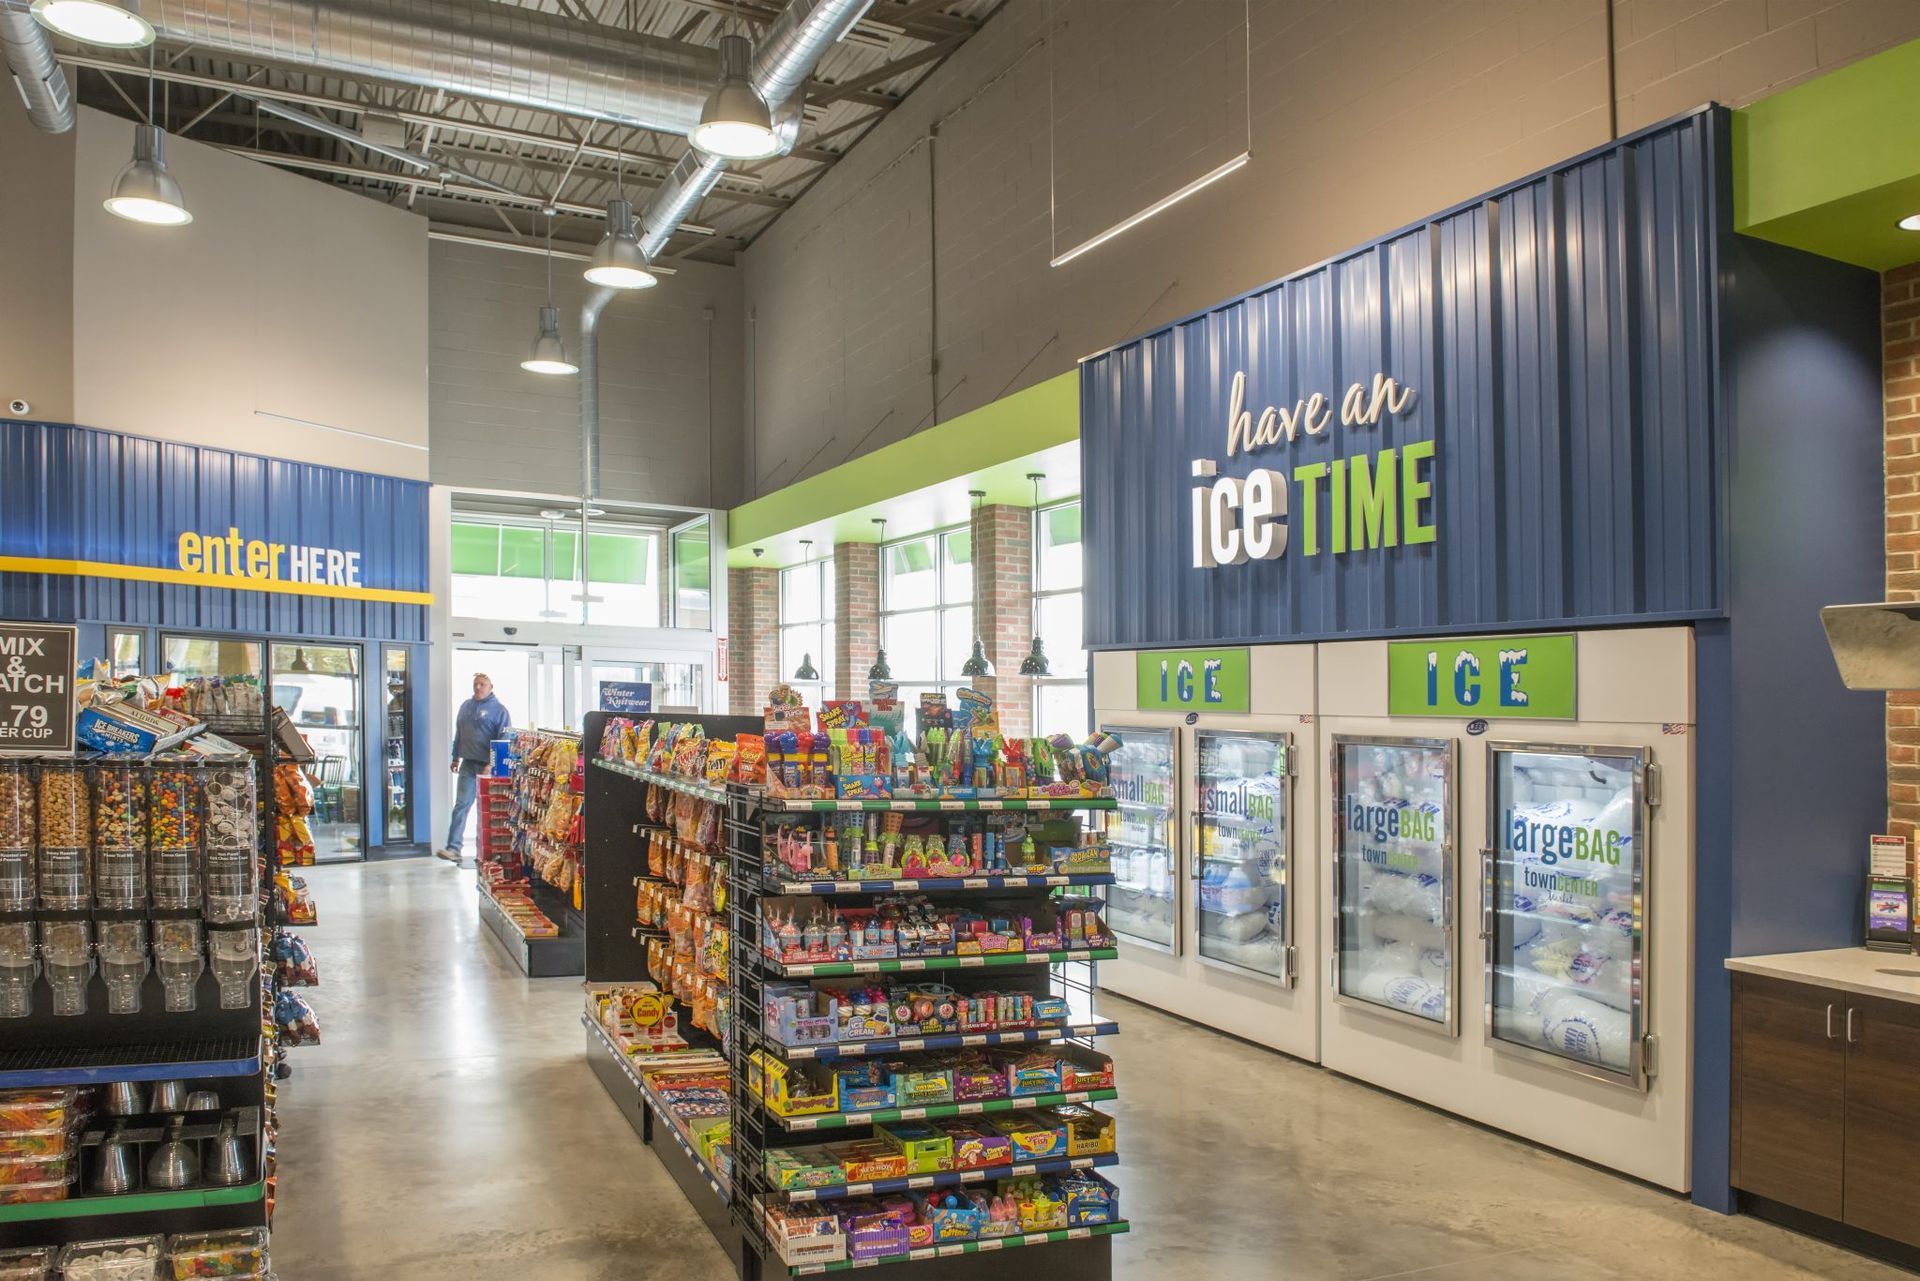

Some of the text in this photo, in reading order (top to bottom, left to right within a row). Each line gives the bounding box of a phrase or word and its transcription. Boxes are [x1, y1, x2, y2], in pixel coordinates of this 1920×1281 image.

[1227, 371, 1411, 456] have an
[1192, 440, 1437, 568] ice TIME
[178, 527, 362, 588] enter HERE
[0, 637, 45, 656] MIX
[6, 656, 27, 675] &
[1161, 659, 1222, 702] ICE
[1427, 648, 1528, 706] ICE
[602, 688, 635, 697] Winter
[607, 696, 650, 708] Knitwear
[22, 728, 53, 738] CUP
[94, 718, 140, 744] ICE BREAKERS
[637, 1008, 660, 1018] Candy
[848, 1029, 875, 1038] CREAM
[850, 1022, 863, 1031] ICE
[1076, 1141, 1099, 1150] HARIBO
